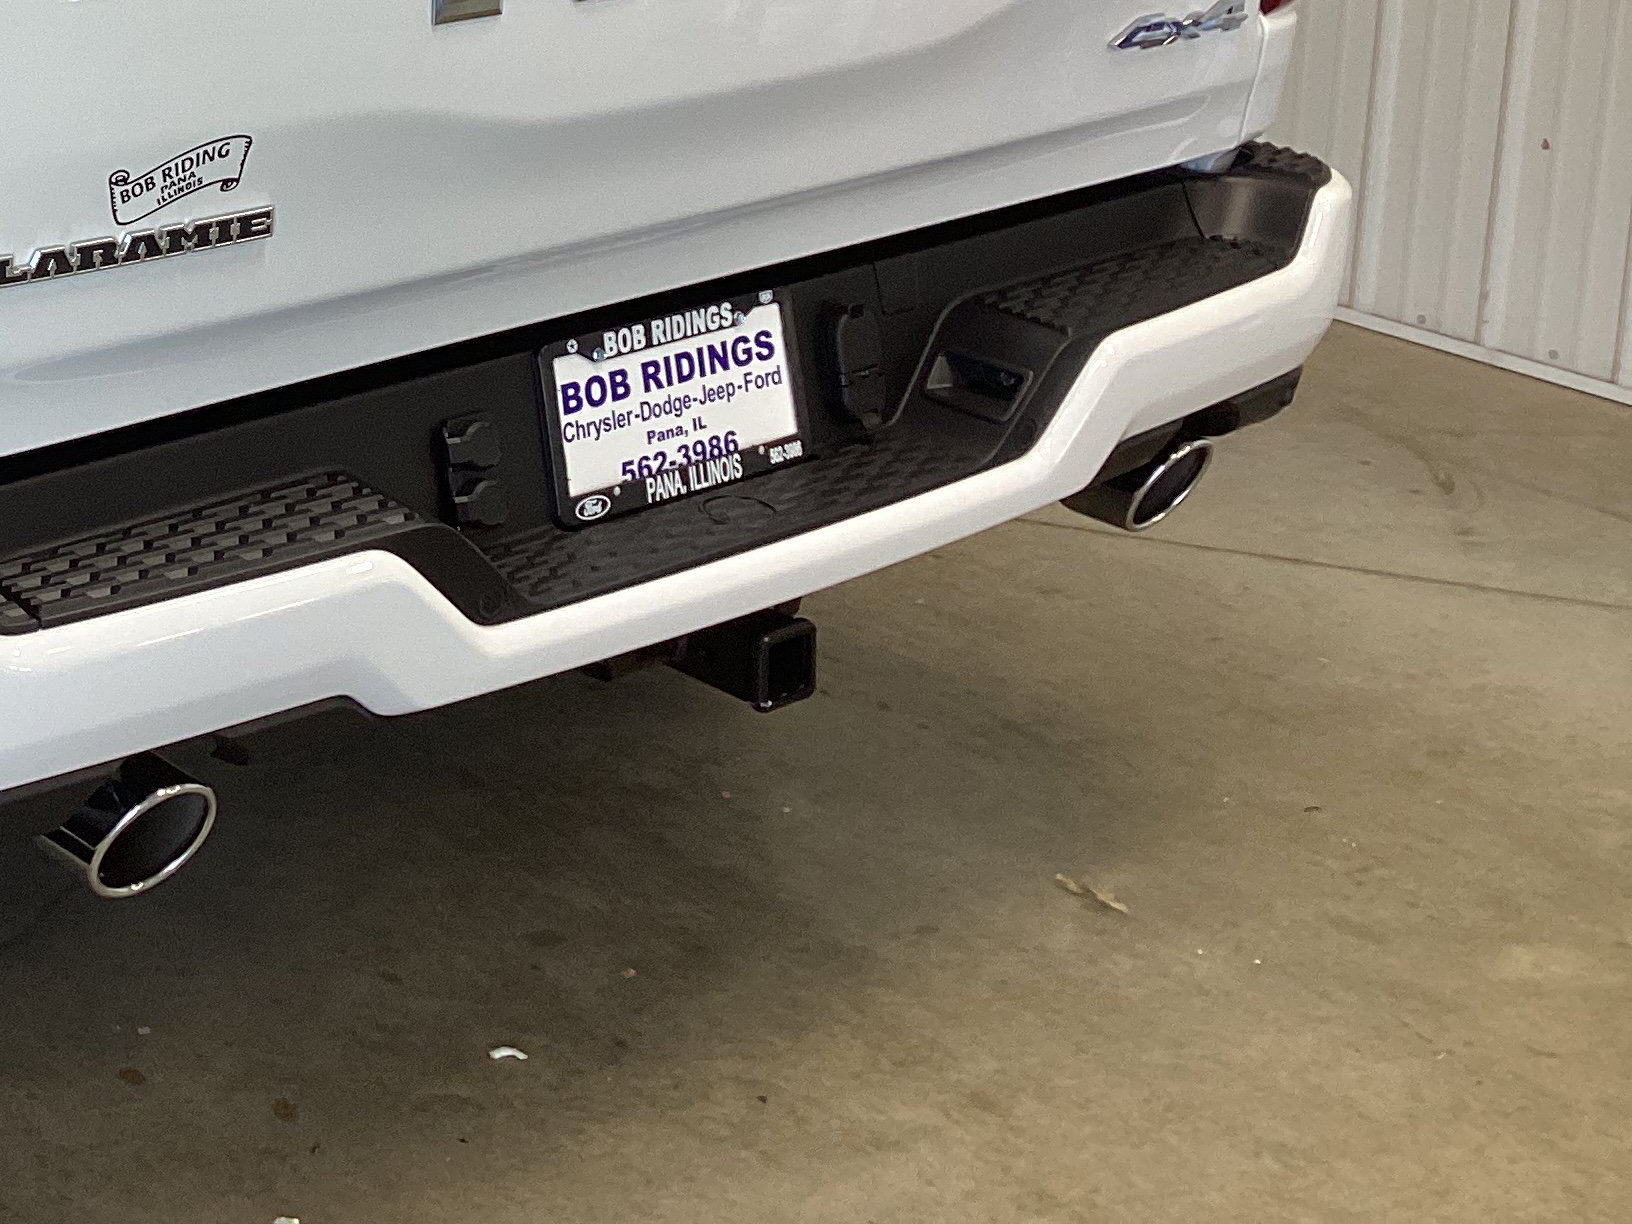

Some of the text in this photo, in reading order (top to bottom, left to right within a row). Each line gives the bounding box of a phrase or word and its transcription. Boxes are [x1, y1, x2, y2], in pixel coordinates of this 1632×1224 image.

[120, 142, 231, 205] BOB RIDING
[156, 176, 204, 207] ILLINOIS
[160, 171, 197, 195] PANA
[602, 302, 735, 358] BOB RIDINGS
[560, 330, 776, 416] BOB RIDINGS
[562, 364, 783, 443] Chrysler-Dodge-Jeep-Ford
[621, 429, 739, 480] 562-3986
[646, 415, 708, 445] Pana, IL
[688, 452, 744, 492] ILLINOIS
